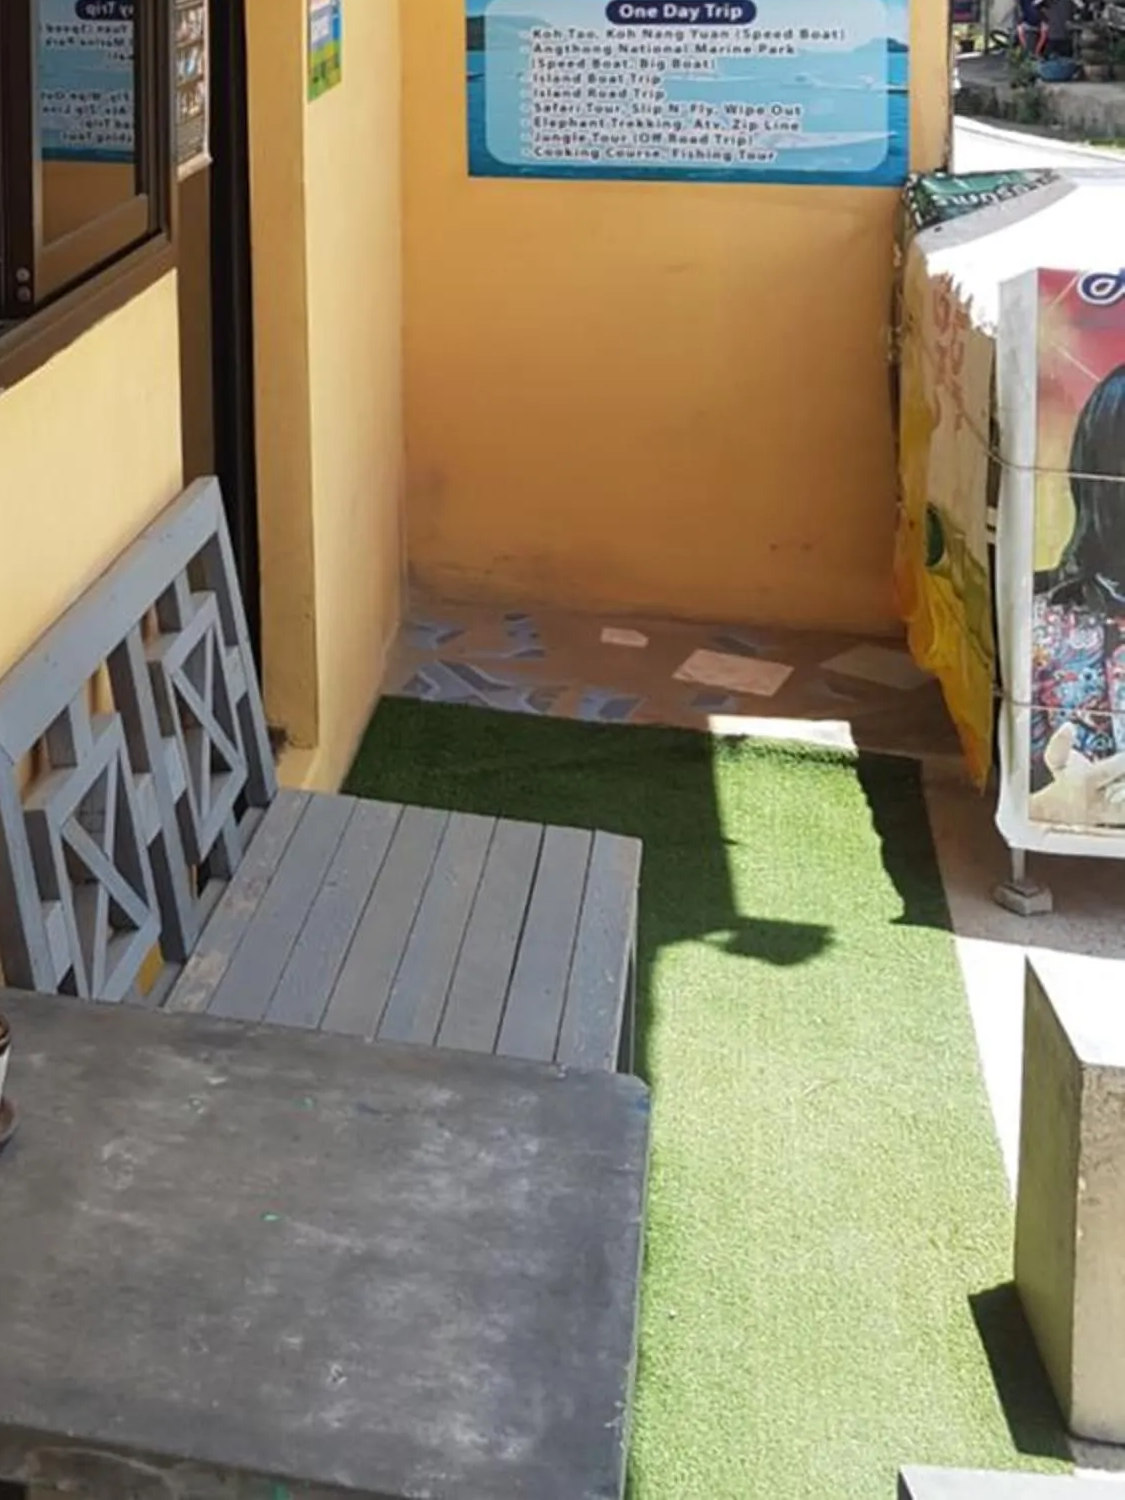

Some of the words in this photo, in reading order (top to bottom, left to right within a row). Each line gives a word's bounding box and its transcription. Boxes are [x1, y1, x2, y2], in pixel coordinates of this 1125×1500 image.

[619, 3, 658, 19] One
[662, 2, 700, 23] Day
[703, 2, 743, 22] Trip
[533, 29, 562, 39] Koh
[606, 29, 636, 39] Koh
[758, 43, 795, 54] Park
[771, 104, 801, 115] Out
